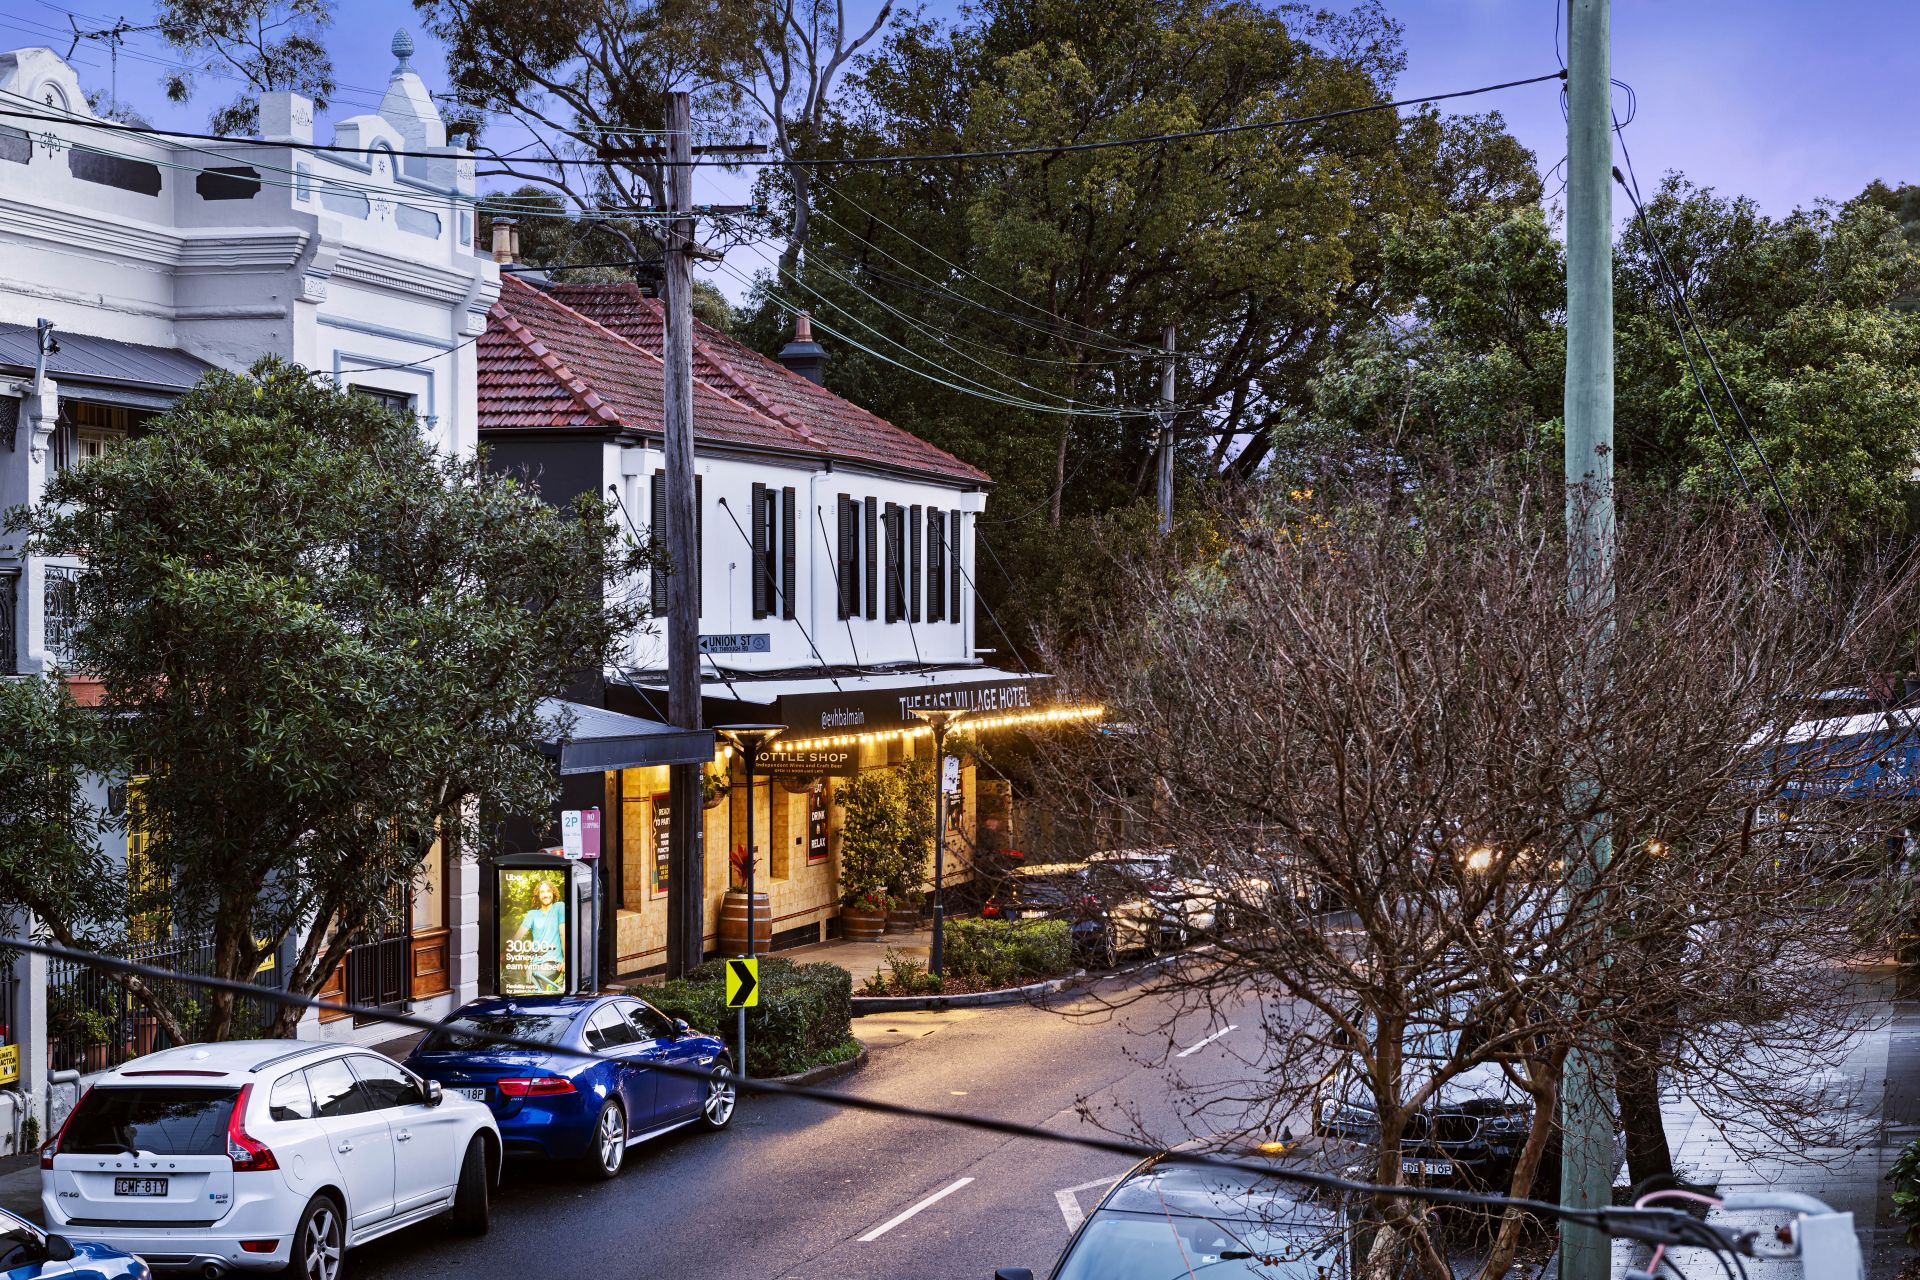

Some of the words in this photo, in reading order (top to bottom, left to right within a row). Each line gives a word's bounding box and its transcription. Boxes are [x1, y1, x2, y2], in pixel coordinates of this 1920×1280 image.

[709, 635, 736, 647] UNION
[740, 635, 751, 646] ST
[899, 695, 921, 720] THE
[954, 688, 998, 712] VILLAGE
[1000, 686, 1031, 709] HOTEL
[821, 707, 865, 730] @evhbalmain
[809, 752, 848, 763] SHOP
[586, 813, 595, 821] NO
[811, 810, 826, 822] DRINK
[565, 817, 578, 827] 2P
[661, 818, 671, 826] PART
[811, 838, 826, 849] RELAX
[505, 952, 534, 963] Sydney
[1, 1056, 16, 1066] ACTION
[98, 1161, 176, 1169] VOLVO
